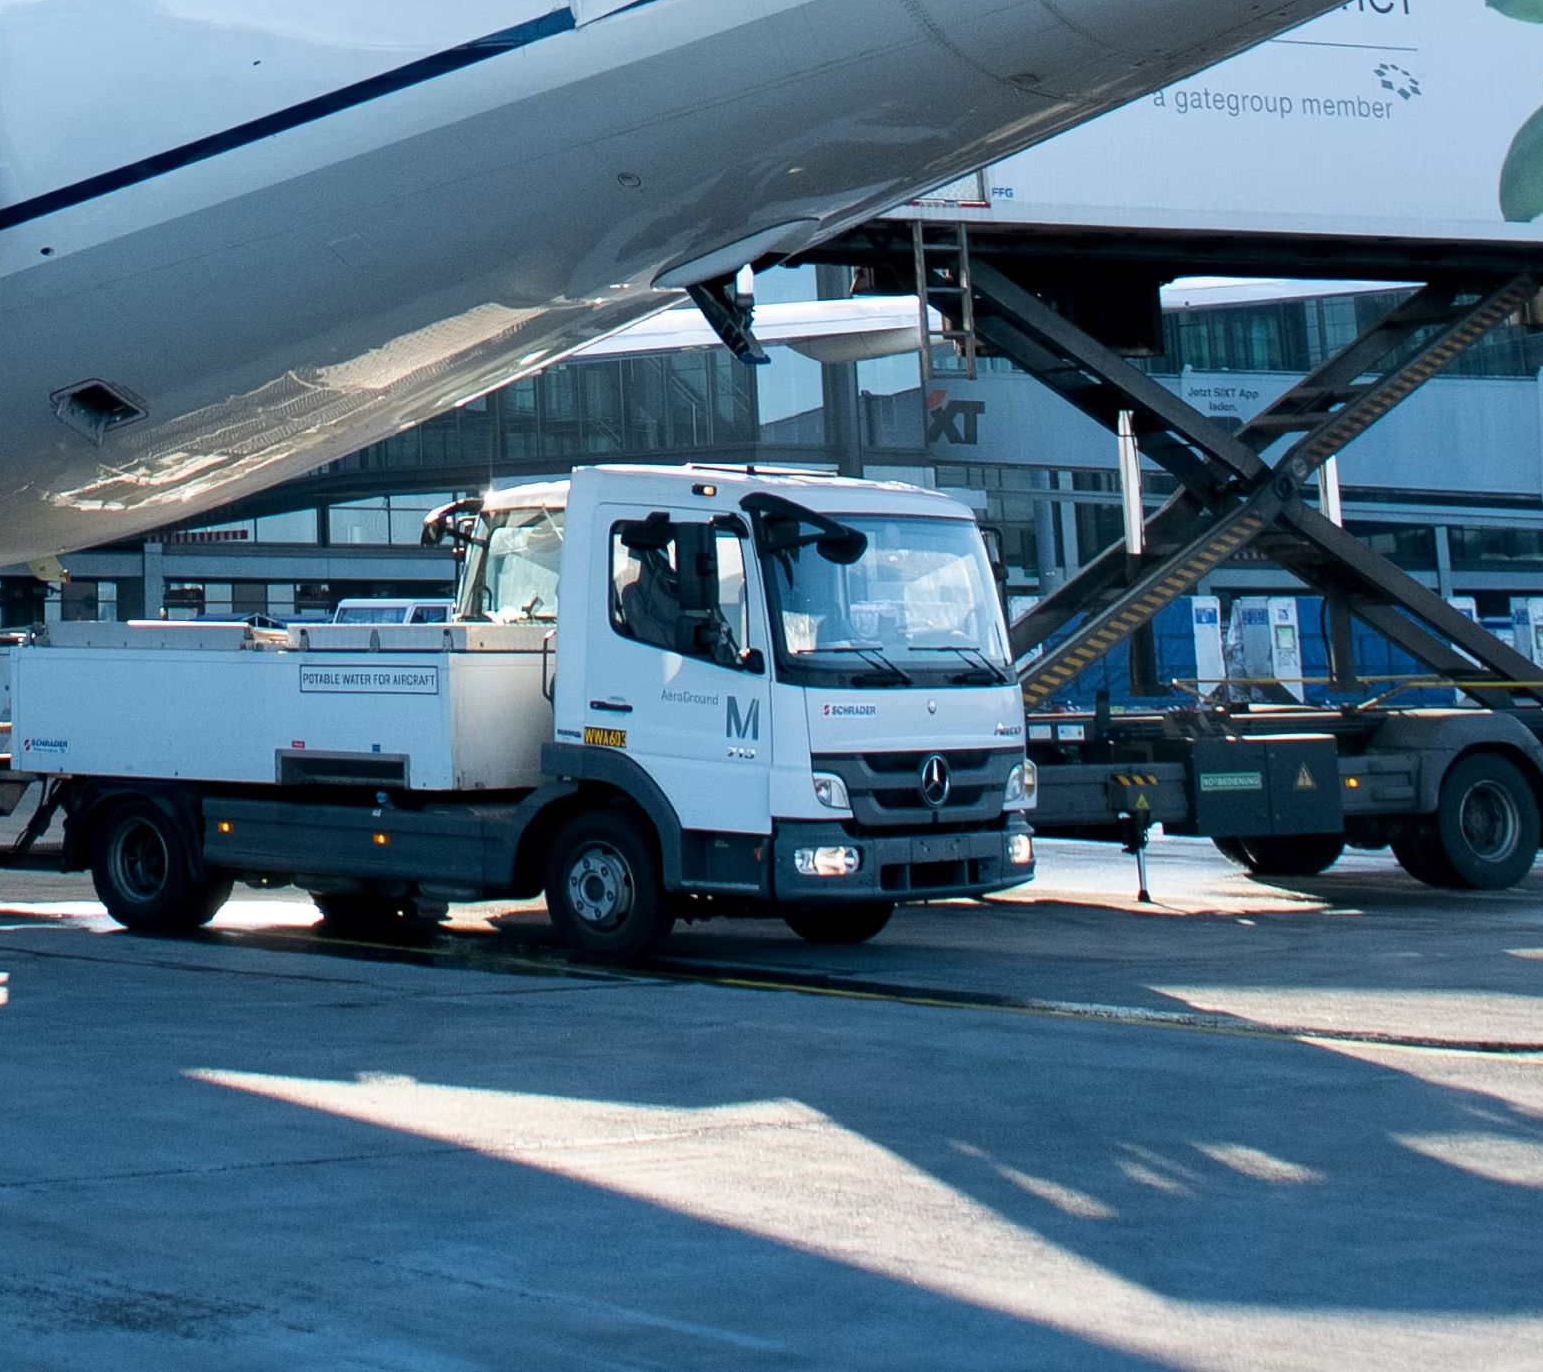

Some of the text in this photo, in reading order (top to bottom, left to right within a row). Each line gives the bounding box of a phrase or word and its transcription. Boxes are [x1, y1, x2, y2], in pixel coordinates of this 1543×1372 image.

[1152, 88, 1394, 119] a gategroup member
[991, 188, 1014, 198] FFG
[1188, 386, 1212, 397] Jetzt
[1239, 388, 1259, 400] App
[302, 673, 435, 686] POTABLE WATER FOR AIRCRAFT
[661, 689, 759, 741] AeroGround M
[832, 706, 876, 716] SCHRADER
